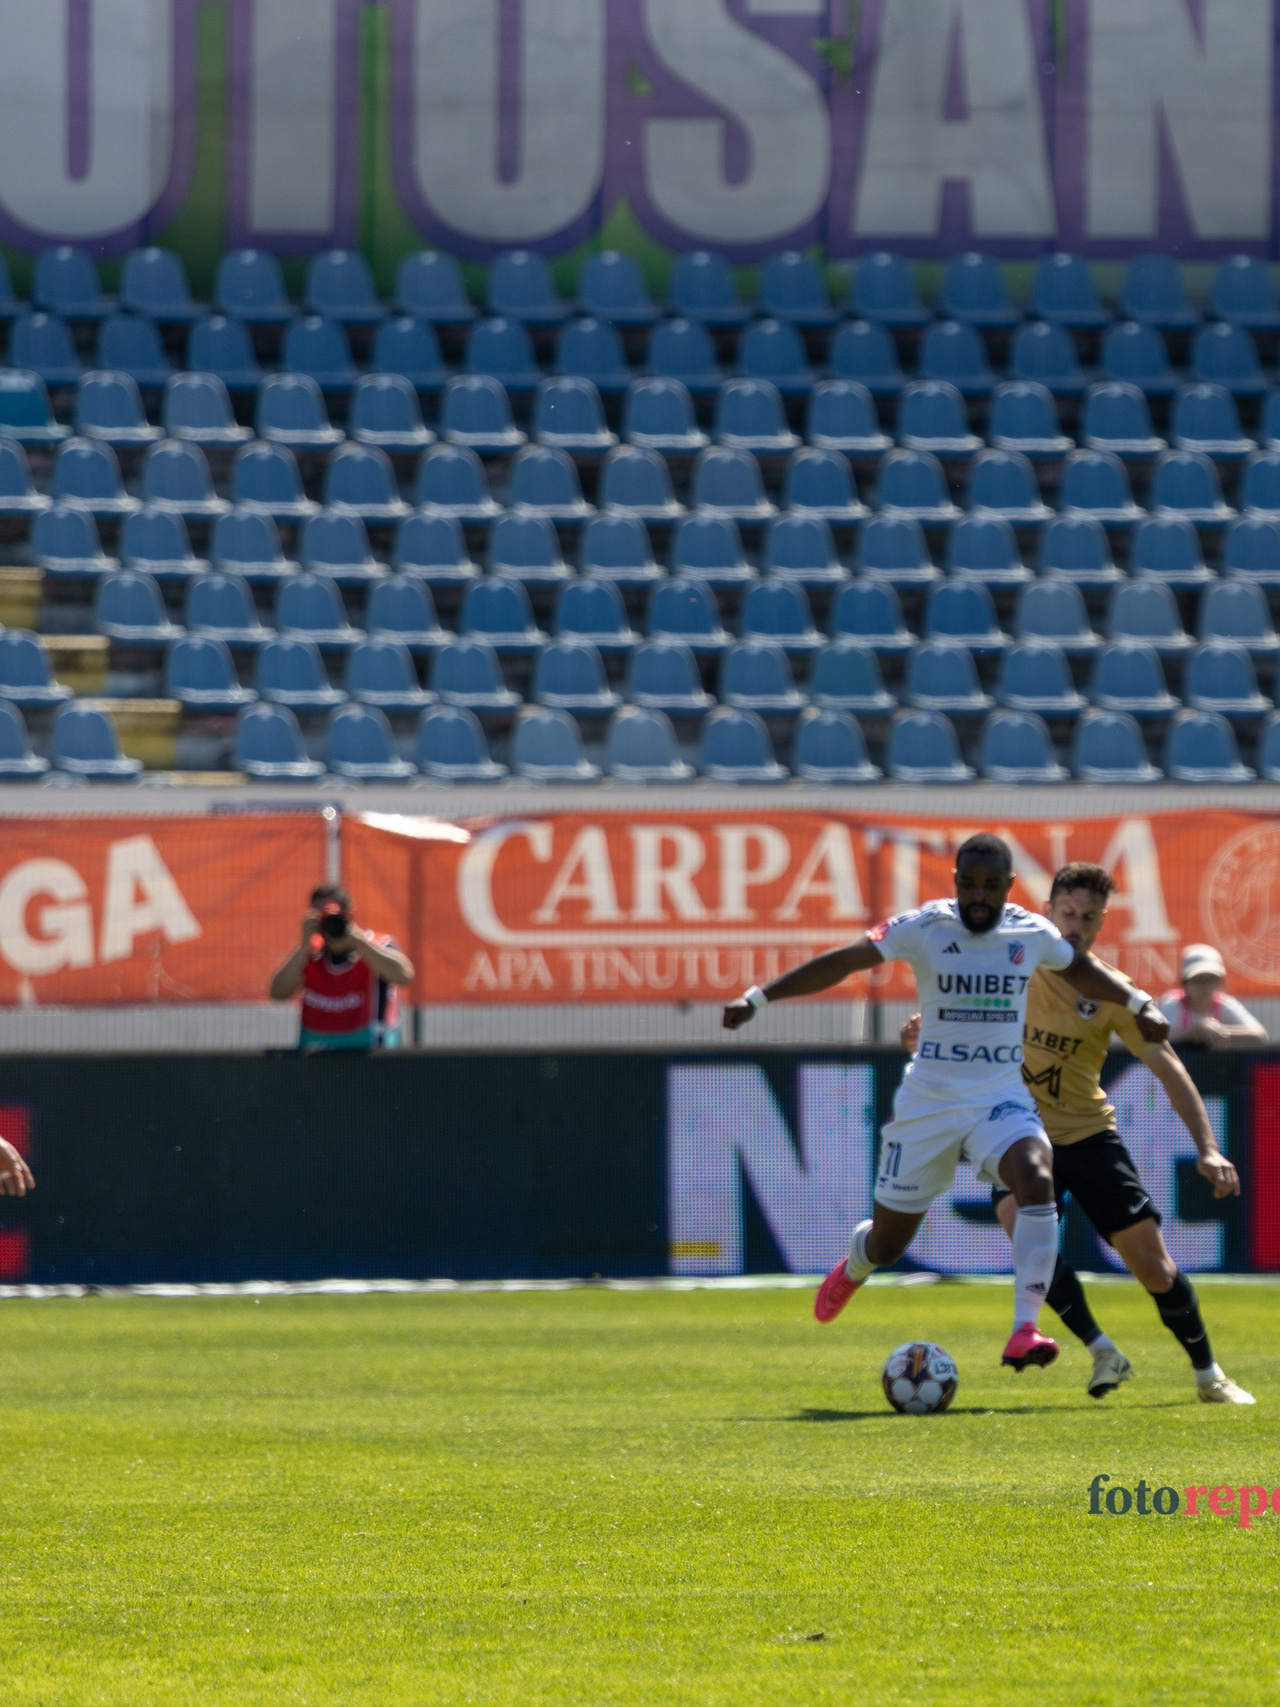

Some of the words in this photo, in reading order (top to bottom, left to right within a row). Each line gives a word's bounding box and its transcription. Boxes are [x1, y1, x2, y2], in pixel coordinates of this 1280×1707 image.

[457, 818, 1181, 946] CARPATNA
[467, 948, 555, 991] APA
[938, 973, 1031, 995] UNIBET
[920, 1041, 1024, 1064] ELSACO
